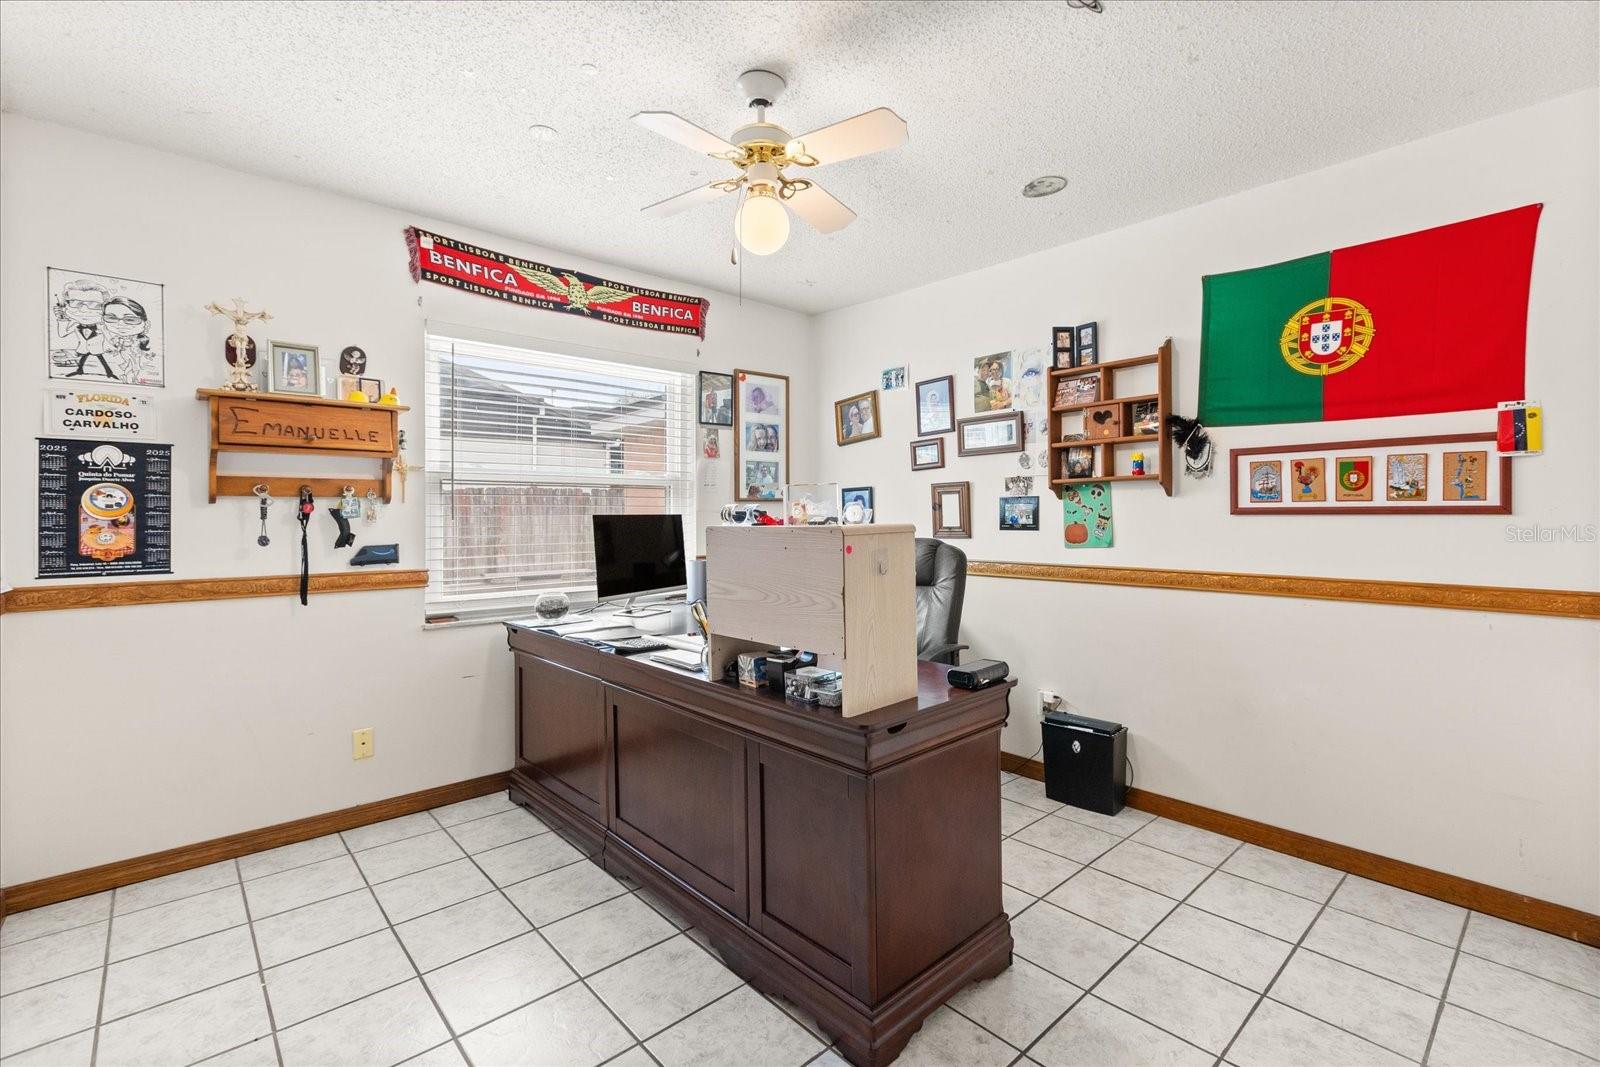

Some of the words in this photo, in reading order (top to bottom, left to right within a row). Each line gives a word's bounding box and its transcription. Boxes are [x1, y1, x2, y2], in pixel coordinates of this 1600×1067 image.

[429, 249, 518, 287] BENFICA
[458, 243, 496, 260] LISBOA
[508, 257, 552, 274] BENFICA
[425, 271, 461, 288] SPORT
[463, 282, 500, 298] LISBOA
[512, 295, 554, 309] BENFICA
[602, 280, 630, 293] SPORT
[632, 287, 661, 299] LISBOA
[668, 294, 700, 304] BENFICA
[632, 301, 693, 321] BENFICA
[602, 314, 630, 326] SPORT
[631, 319, 659, 330] LISBOA
[660, 323, 666, 331] E
[667, 325, 697, 335] BENFICA
[76, 393, 130, 406] FLORIDA
[65, 408, 137, 419] CARDOSO-
[63, 419, 139, 430] CARVALHO
[229, 407, 380, 443] EMANUELLE
[39, 444, 68, 452] 2025
[146, 449, 171, 457] 2025
